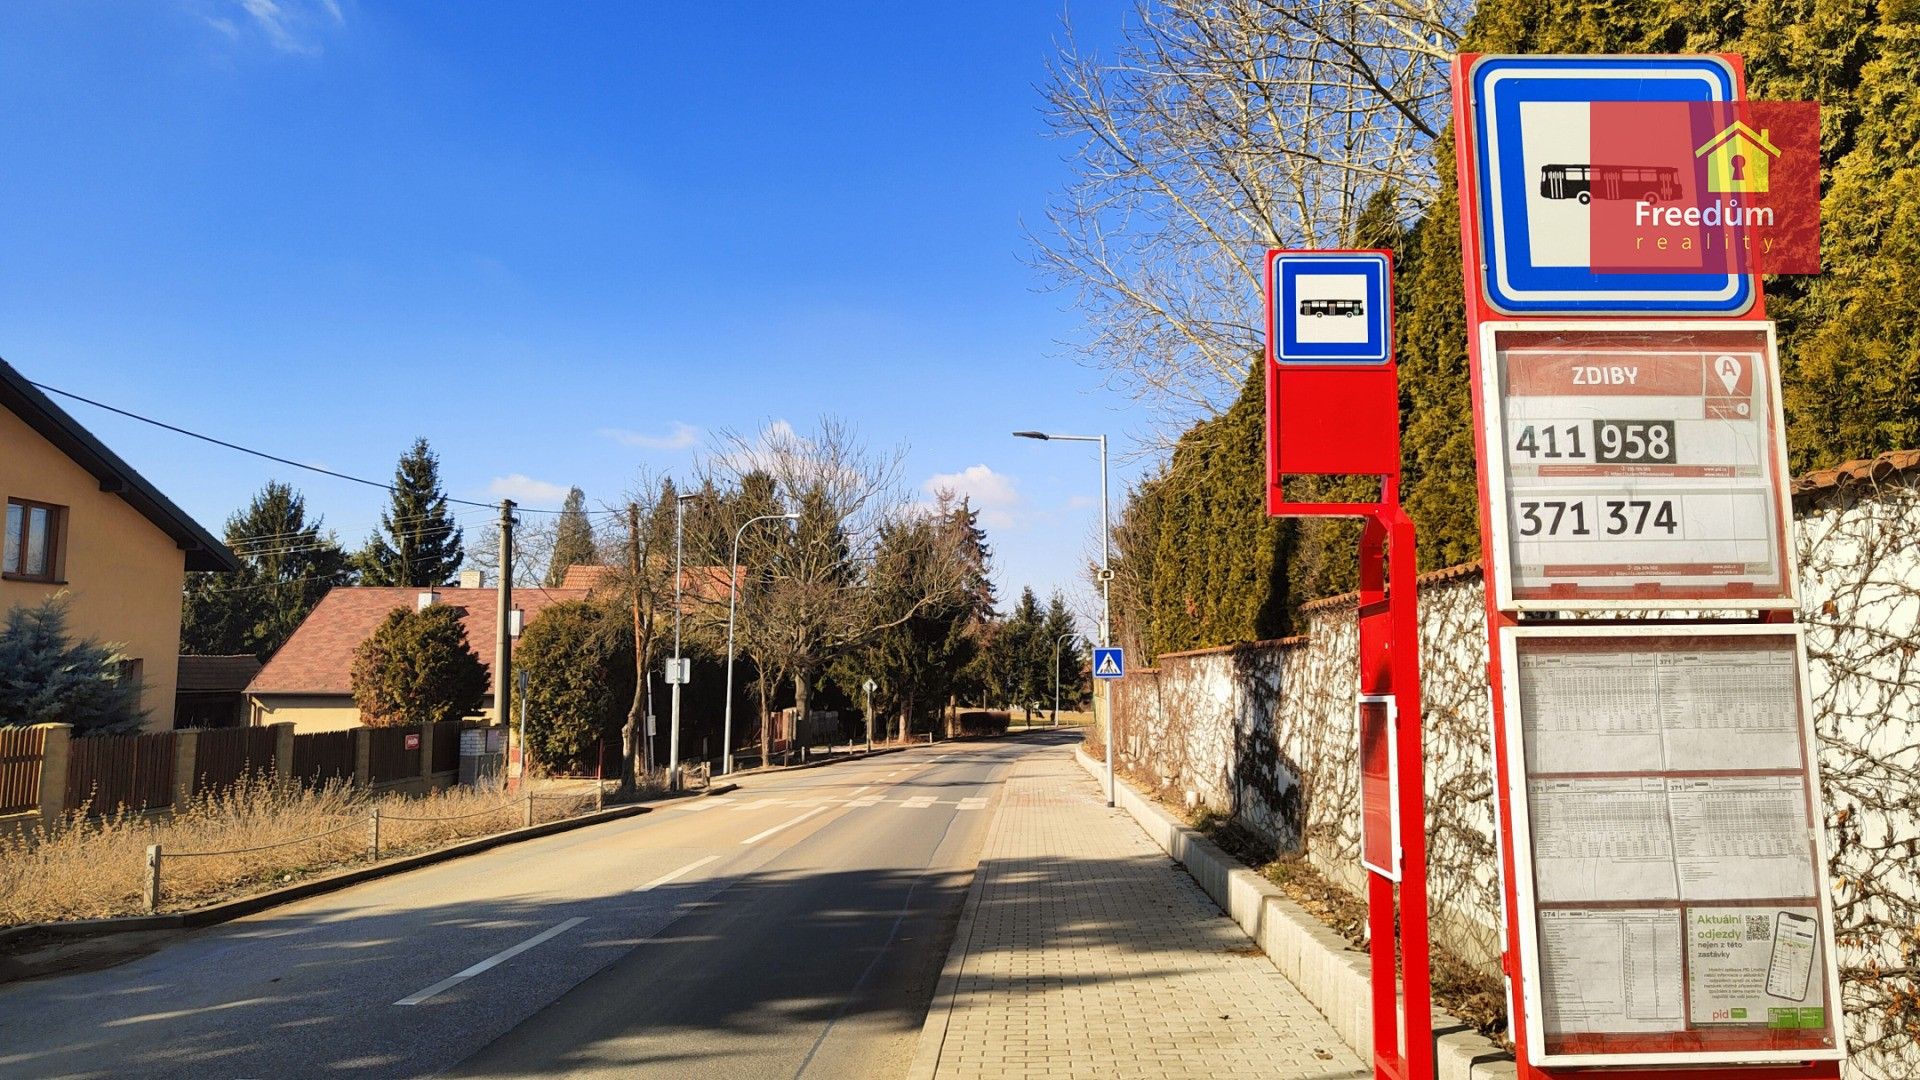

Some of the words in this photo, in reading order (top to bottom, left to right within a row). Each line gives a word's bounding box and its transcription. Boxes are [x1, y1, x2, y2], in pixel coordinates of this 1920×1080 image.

[1722, 360, 1737, 376] A
[1572, 366, 1638, 385] ZDIBY
[1516, 424, 1586, 459] 411
[1600, 424, 1671, 460] 958
[1520, 501, 1590, 536] 371
[1607, 500, 1677, 535] 374
[1697, 915, 1742, 924] Aktuální
[1698, 929, 1741, 940] odjezdy
[1698, 942, 1717, 950] nejen
[1698, 952, 1731, 960] zastávky
[1712, 1009, 1729, 1021] pid
